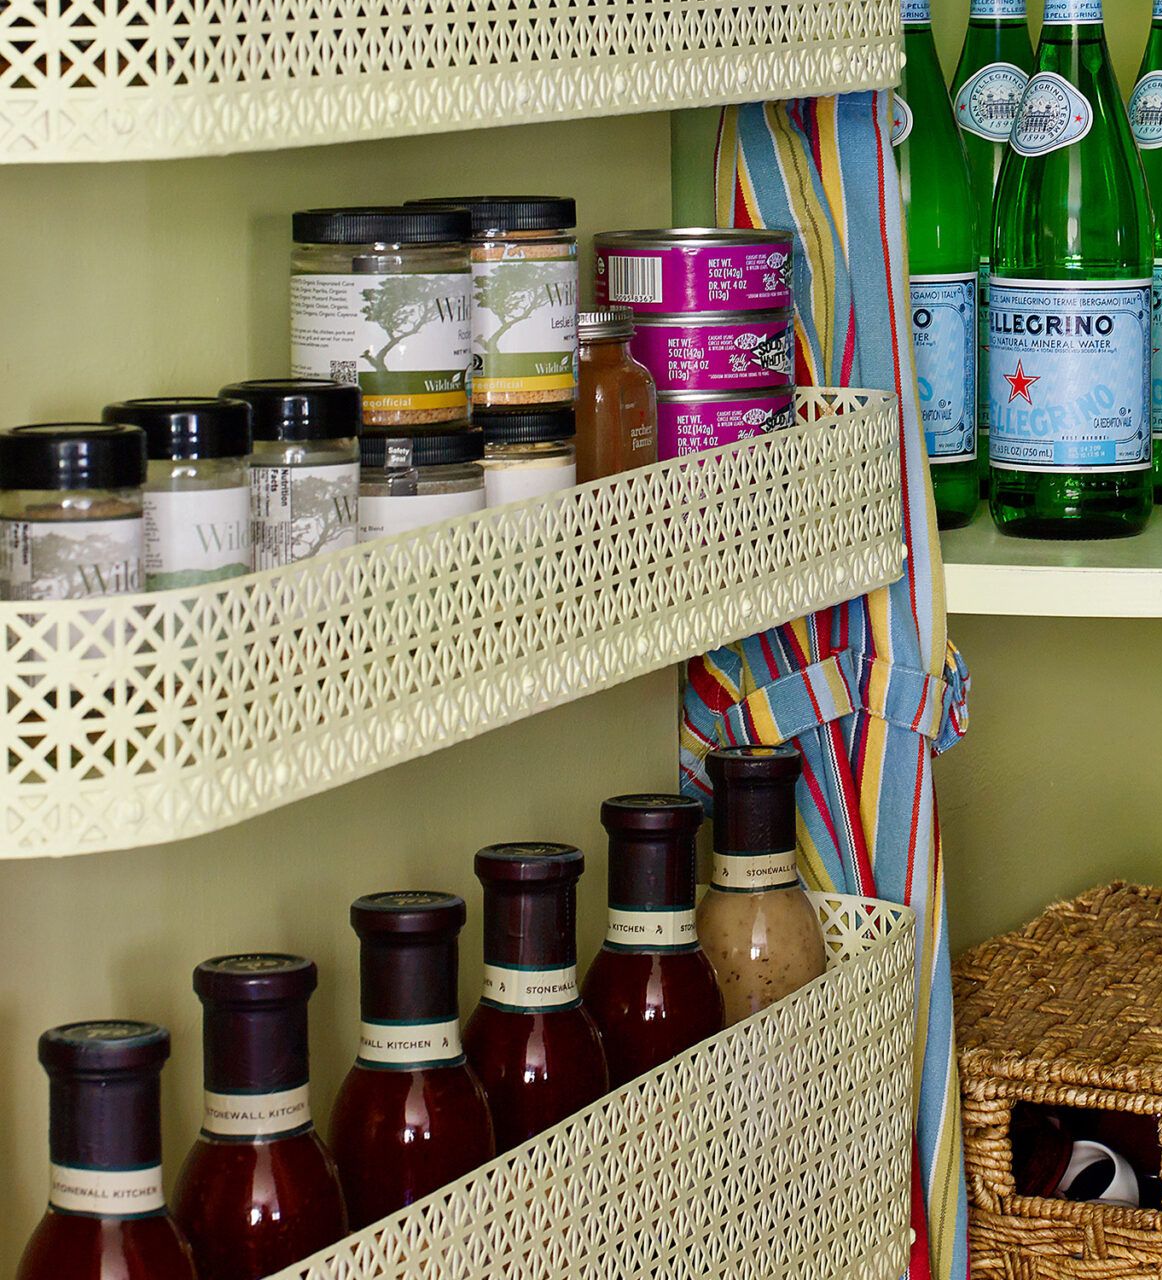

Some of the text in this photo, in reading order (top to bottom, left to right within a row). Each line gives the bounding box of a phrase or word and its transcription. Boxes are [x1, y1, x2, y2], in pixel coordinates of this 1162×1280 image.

[708, 259, 732, 267] NET WT.
[709, 268, 743, 279] 5 OZ (142g)
[709, 280, 747, 290] DR. WT. 4 OZ
[709, 290, 729, 301] (113g)
[1000, 295, 1137, 307] SAN PELLEGRINO TERME (BERGAMO) ITALY
[999, 339, 1111, 349] NATURAL MINERAL WATER
[728, 353, 746, 364] Half
[388, 446, 410, 457] Safety
[270, 468, 278, 493] Facts
[281, 468, 289, 506] Nutrition
[746, 864, 792, 877] STONEWALL
[612, 923, 645, 934] KITCHEN
[525, 982, 576, 996] STONEWALL
[206, 1102, 305, 1120] STONEWALL KITCHEN
[52, 1182, 158, 1199] STONEWALL KITCHEN
